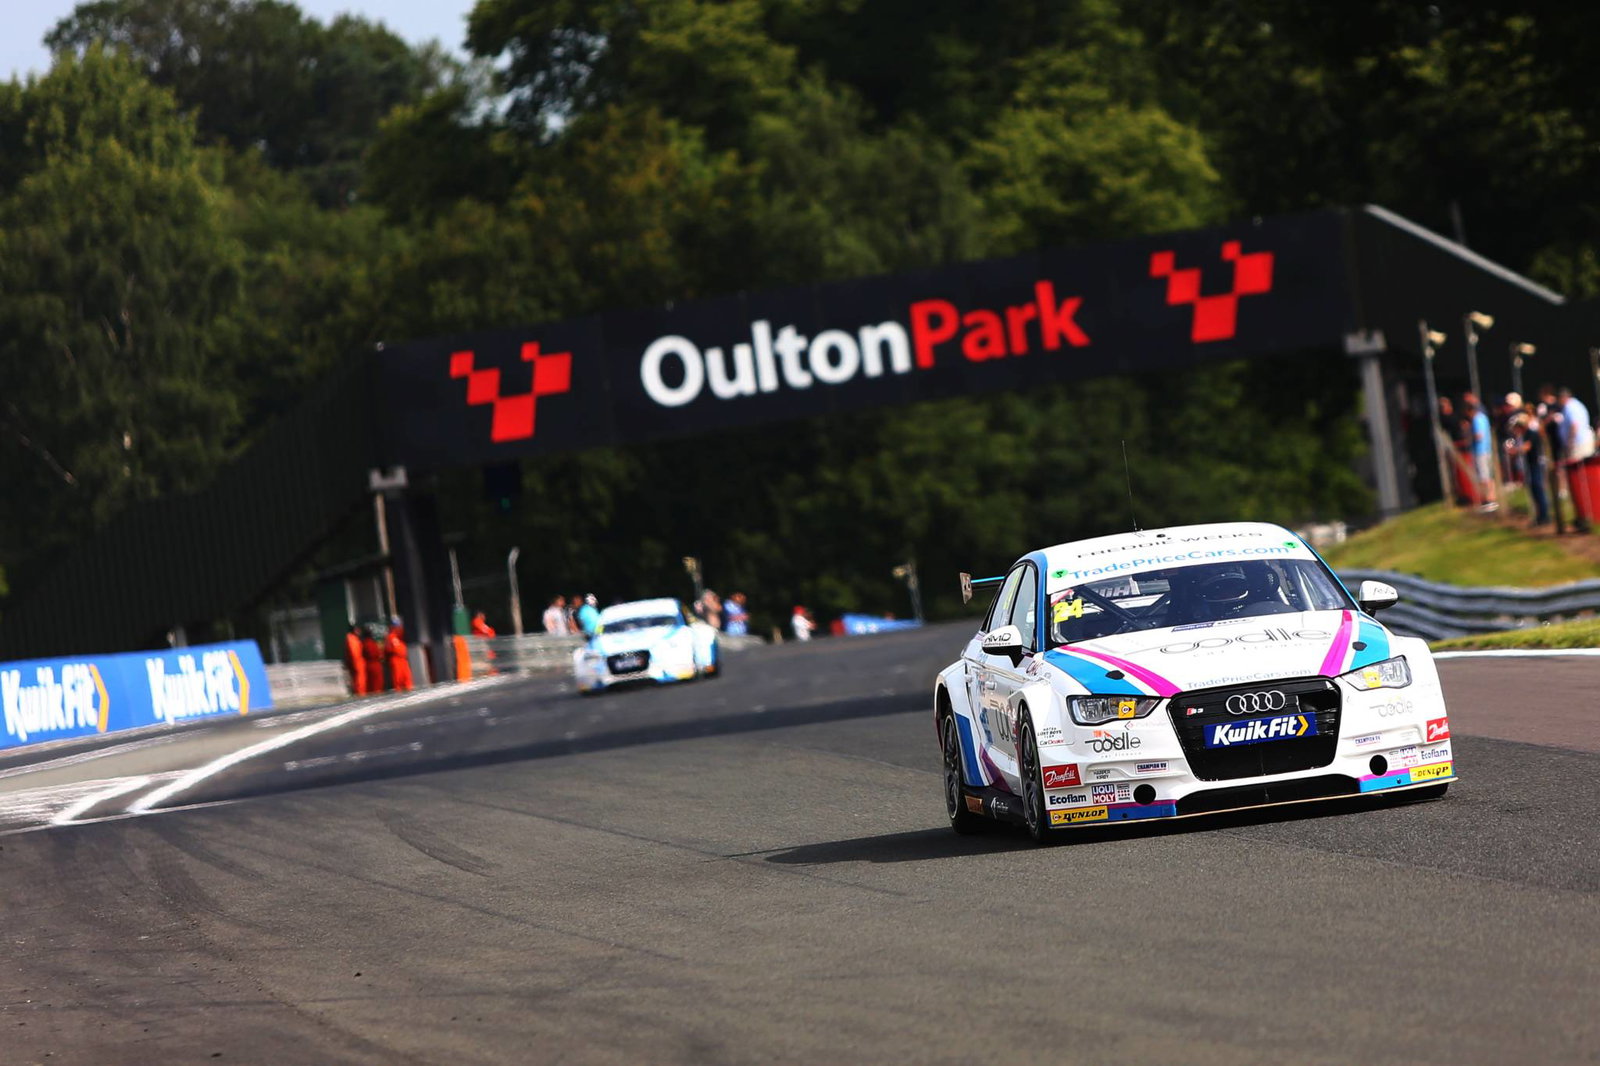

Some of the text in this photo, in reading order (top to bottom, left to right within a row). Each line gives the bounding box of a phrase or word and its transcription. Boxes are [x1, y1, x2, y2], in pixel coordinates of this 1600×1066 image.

[1179, 532, 1263, 543] WEEKS
[1069, 545, 1290, 581] TradePriceCars.com
[1053, 598, 1084, 624] 24
[1186, 667, 1312, 690] TradePriceCars.com
[1421, 747, 1449, 760] Ecoflam
[1417, 766, 1449, 777] DUNLOP
[1092, 785, 1114, 795] LIQUI
[1049, 794, 1087, 805] Ecoflam
[1093, 794, 1116, 804] MOLY
[1063, 809, 1106, 821] DUNLOP
